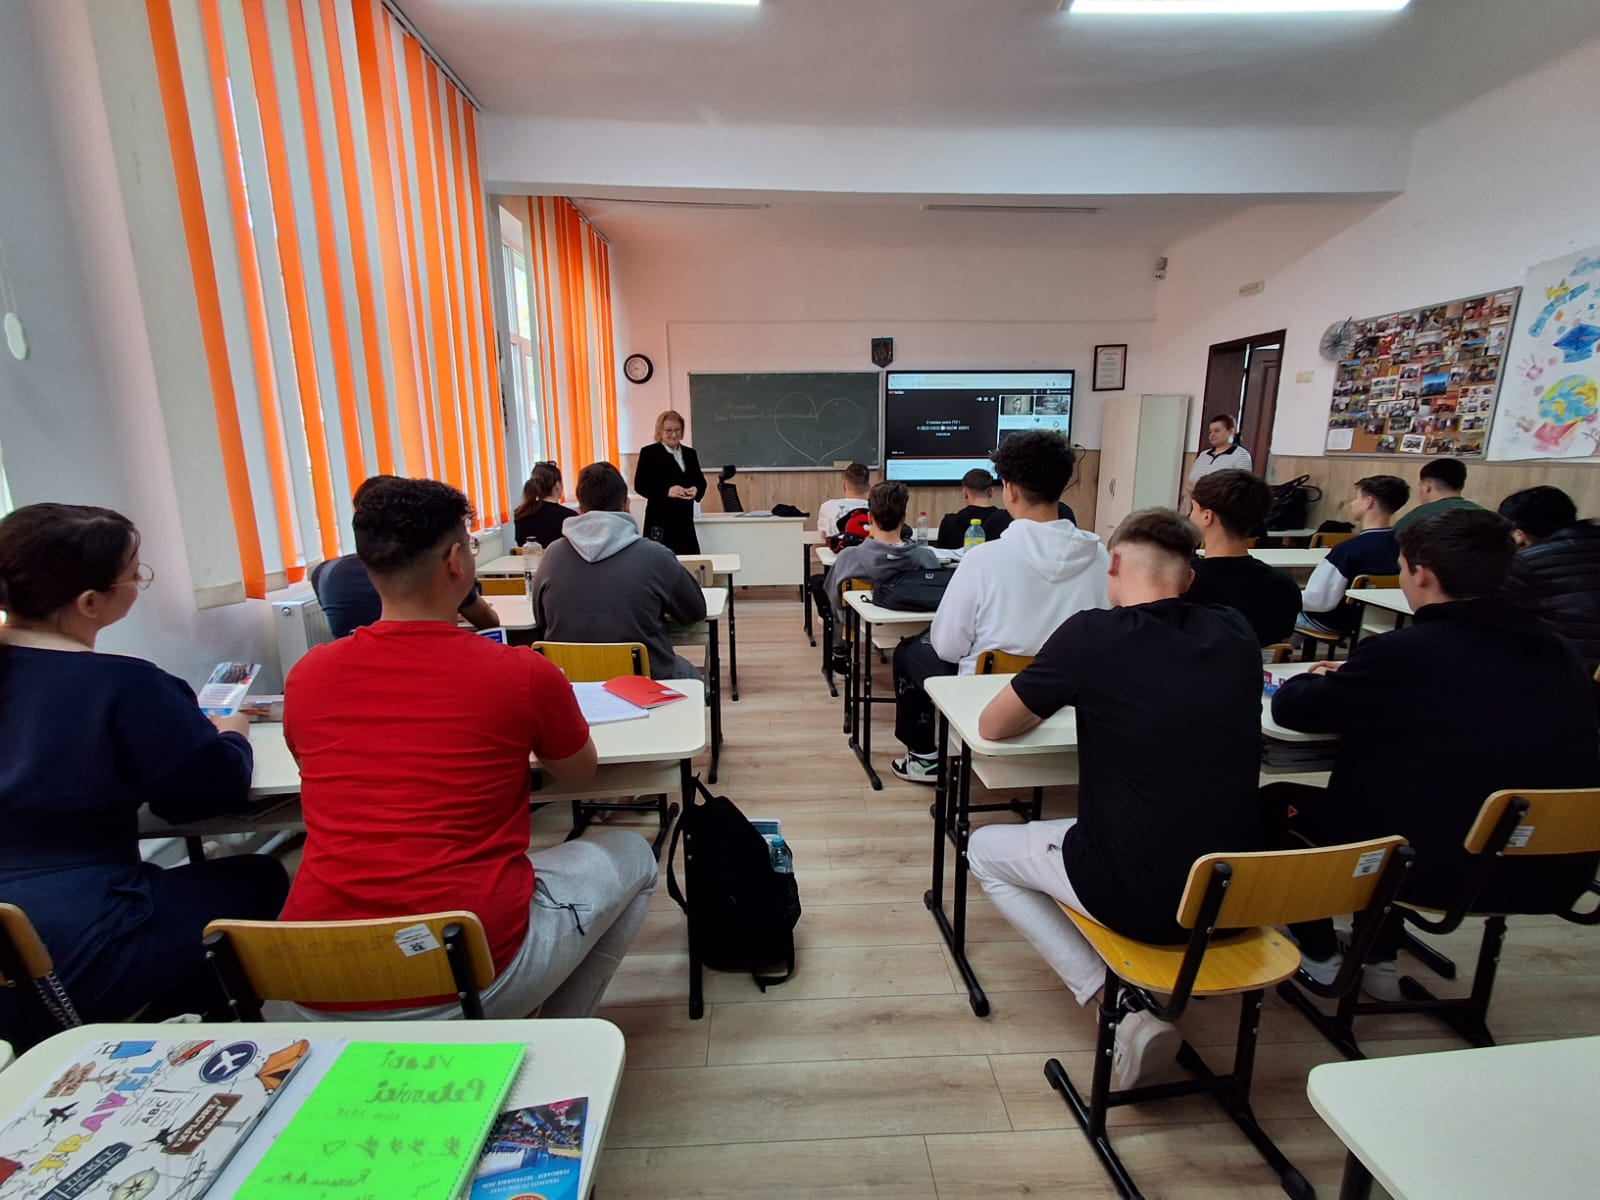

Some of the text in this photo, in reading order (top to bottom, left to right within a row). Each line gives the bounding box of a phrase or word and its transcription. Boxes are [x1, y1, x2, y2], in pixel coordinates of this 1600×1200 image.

[28, 1059, 163, 1176] TRAVEL
[141, 1100, 168, 1124] ABC
[189, 1105, 229, 1142] Travel
[64, 1148, 116, 1188] TICKET
